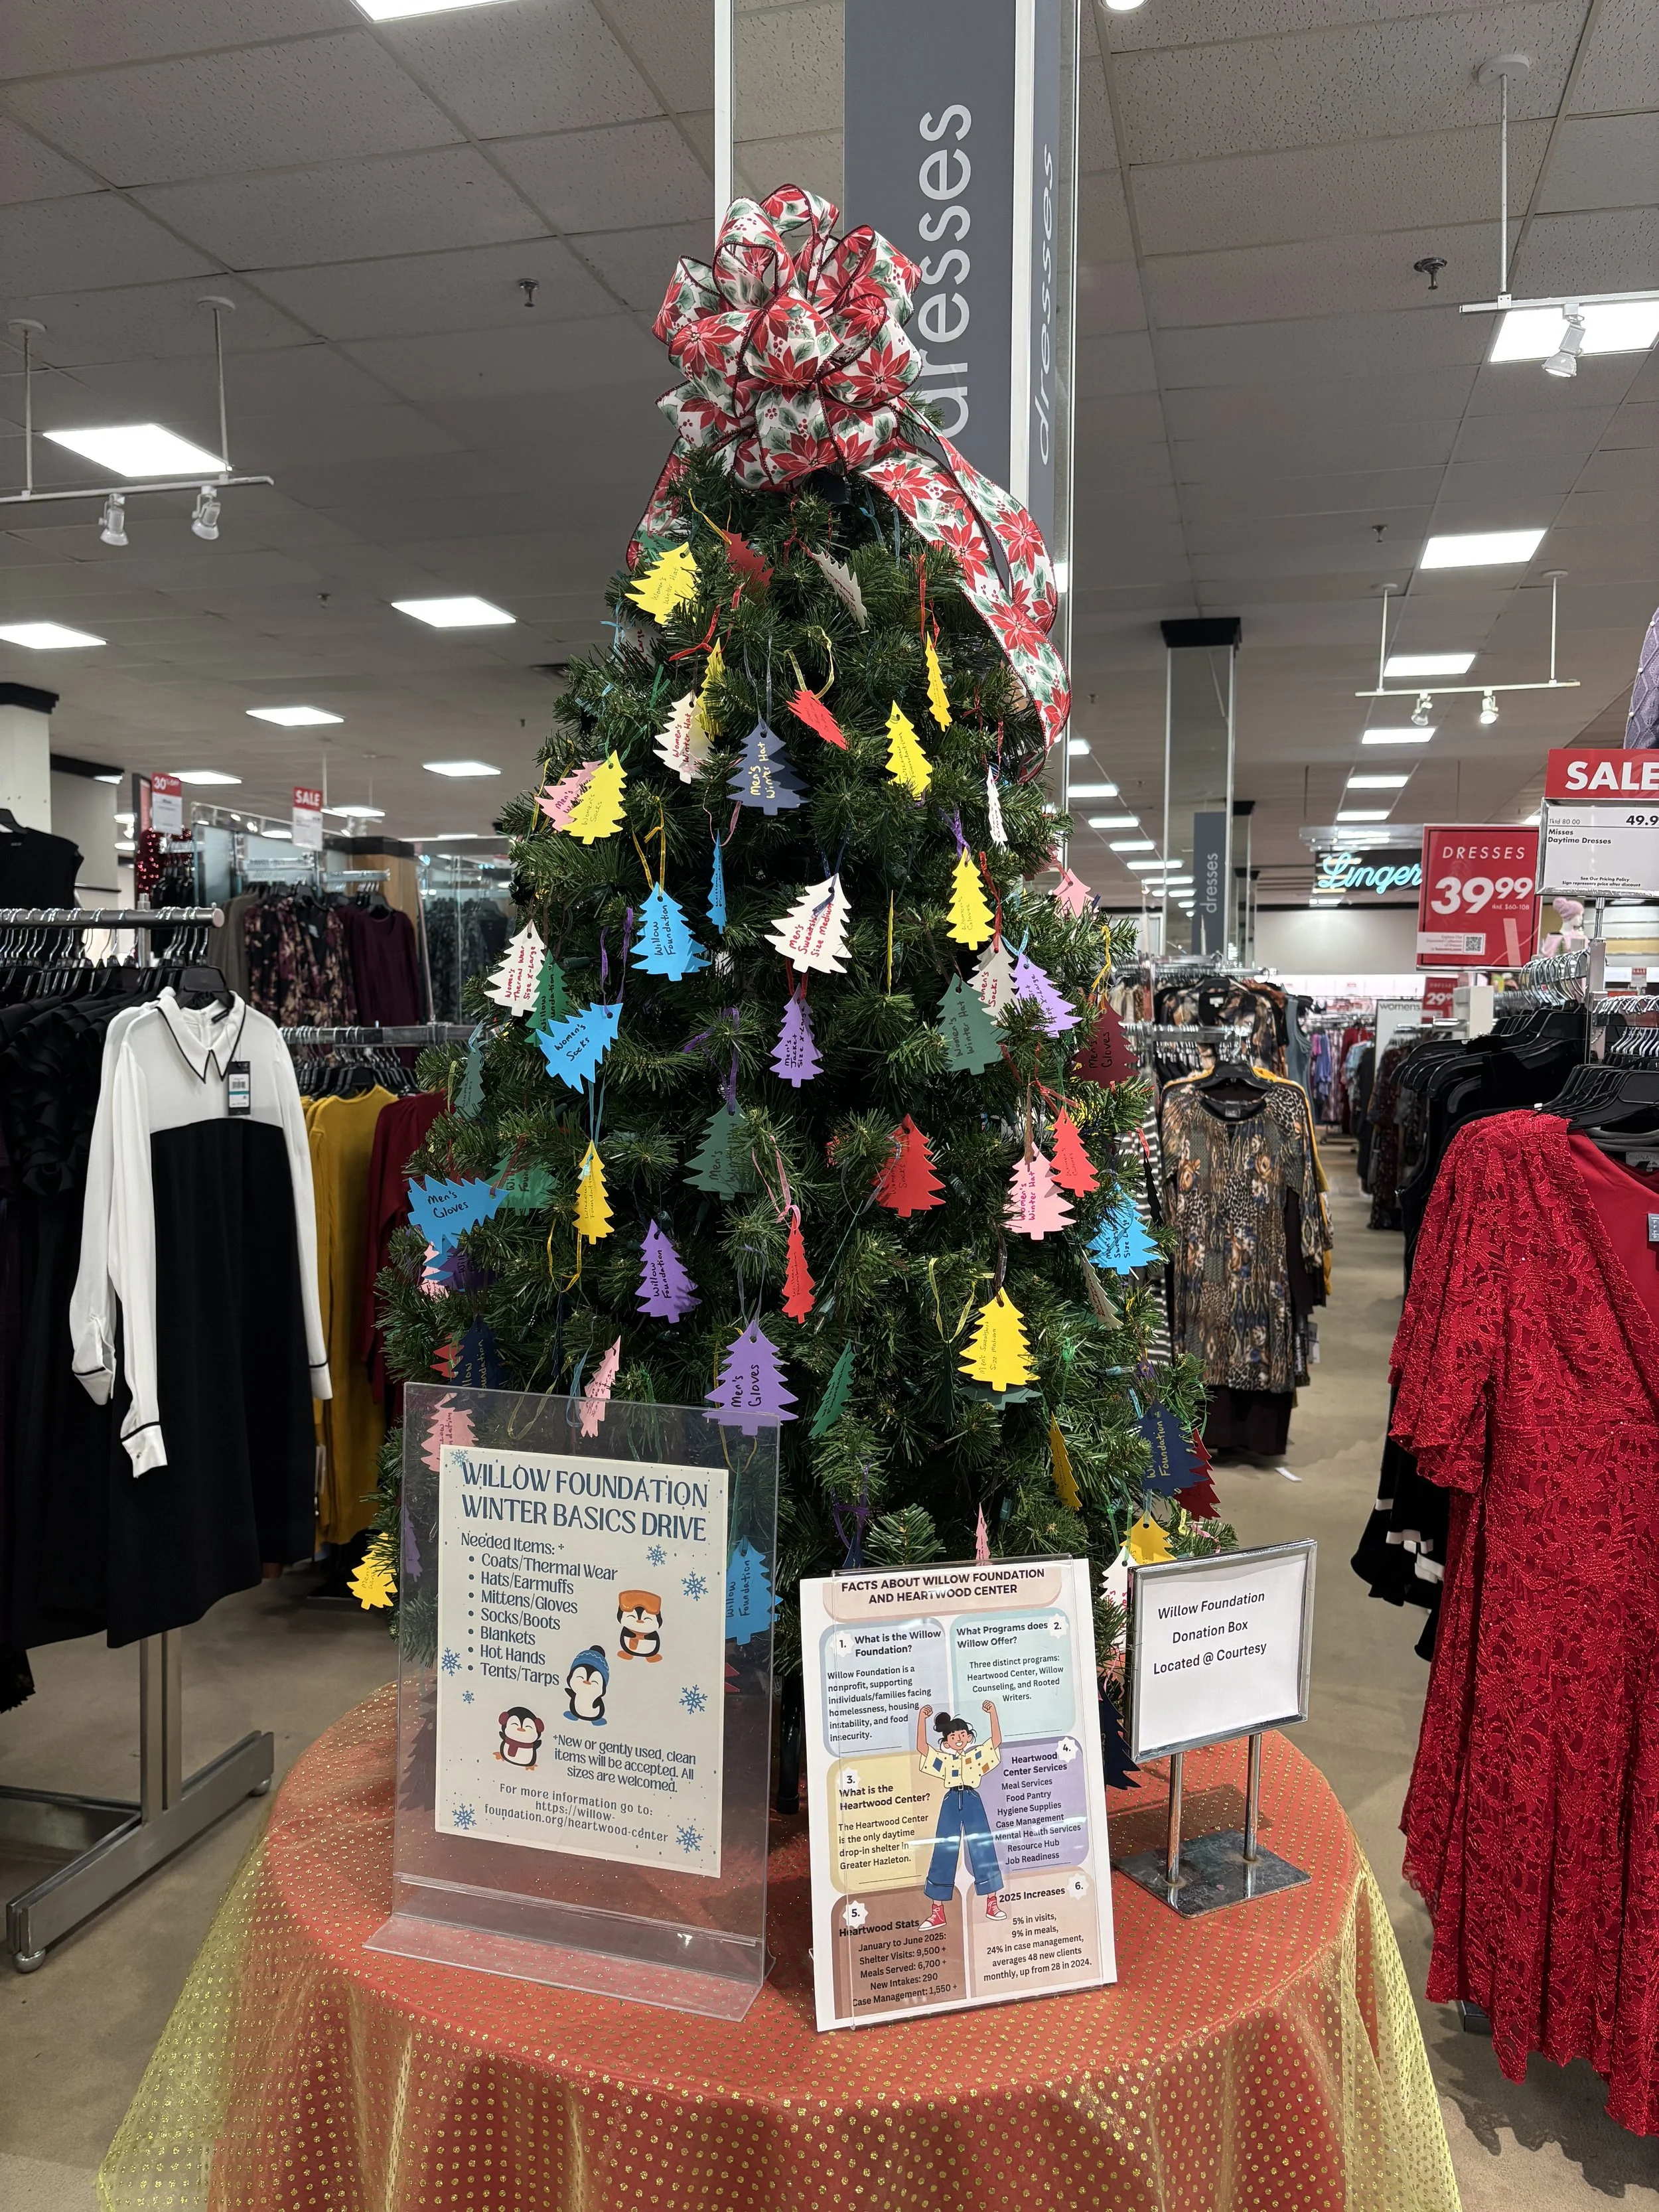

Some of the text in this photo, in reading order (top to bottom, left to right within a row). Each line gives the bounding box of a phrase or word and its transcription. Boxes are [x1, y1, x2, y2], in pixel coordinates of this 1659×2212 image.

[1031, 143, 1054, 466] dresses
[673, 723, 682, 758] Women's
[682, 733, 691, 763] Winter
[751, 765, 761, 796] Men's
[758, 741, 775, 798] Winter Hat
[1565, 761, 1659, 791] SALE
[296, 790, 320, 806] SALE
[555, 790, 574, 810] Men's
[1442, 847, 1526, 860] DRESSES
[1200, 852, 1218, 913] dresses
[652, 921, 663, 956] Willow
[661, 904, 676, 956] Foundation
[788, 924, 804, 950] Men's
[810, 902, 834, 958] Size Medium
[988, 978, 998, 1007] Socks
[1379, 1002, 1421, 1011] womens
[553, 1023, 587, 1051] Women's
[948, 1017, 963, 1057] Women's
[957, 1000, 975, 1055] Winter Hat
[566, 1037, 590, 1062] Socks
[784, 1039, 792, 1067] Men's
[1101, 1031, 1113, 1069] Gloves
[427, 1191, 458, 1205] Men's
[433, 1201, 469, 1218] Gloves
[657, 1249, 672, 1299] Foundation
[731, 1375, 743, 1408] Men's
[748, 1364, 762, 1407] Gloves
[1157, 1420, 1171, 1477] Foundation
[462, 1461, 707, 1507] WILLOW FOUNDATION
[462, 1494, 706, 1541] WINTER BASICS DRIVE
[461, 1532, 510, 1550] Needed
[482, 1553, 618, 1580] Coats/Thermal Wear
[482, 1572, 573, 1594] Hats/Earmuffs
[738, 1559, 751, 1617] Foundation
[841, 1569, 1045, 1592] FACTS ABOUT WILLOW FOUNDATION
[482, 1589, 577, 1613] Mittens/Gloves
[726, 1581, 736, 1618] Willow
[869, 1584, 1017, 1604] AND HEARTWOOD CENTER
[1158, 1593, 1265, 1619] Willow Foundation
[481, 1608, 560, 1630] Socks/Boots
[956, 1627, 981, 1636] What
[983, 1623, 1025, 1635] Programs
[481, 1626, 536, 1645] Blankets
[855, 1635, 880, 1644] What
[909, 1631, 941, 1639] Willow
[958, 1637, 1017, 1649] Willow Offer?
[1173, 1621, 1248, 1644] Donation Box
[480, 1645, 545, 1665] Hot Hands
[855, 1645, 912, 1657] Foundation?
[1154, 1643, 1267, 1674] Located @ Courtesy
[480, 1662, 559, 1686] Tents/Tarps
[585, 1740, 597, 1749] or
[599, 1739, 632, 1757] gently
[635, 1746, 664, 1762] used,
[667, 1751, 695, 1765] clean
[1012, 1751, 1057, 1764] Heartwood
[1063, 1743, 1071, 1752] 4.
[555, 1748, 693, 1780] items will be accepted. All
[1003, 1763, 1067, 1777] Center Services
[567, 1765, 678, 1793] sizes are welcomed.
[500, 1783, 653, 1816] For more information go to:
[536, 1801, 616, 1820] https://willow-
[485, 1801, 668, 1842] foundation.org/heartwood-center
[999, 1888, 1065, 1903] 2025 Increases
[1075, 1881, 1083, 1890] 6.
[983, 1969, 1018, 1982] monthly,
[1020, 1967, 1030, 1976] up
[1071, 1958, 1092, 1968] 2024.
